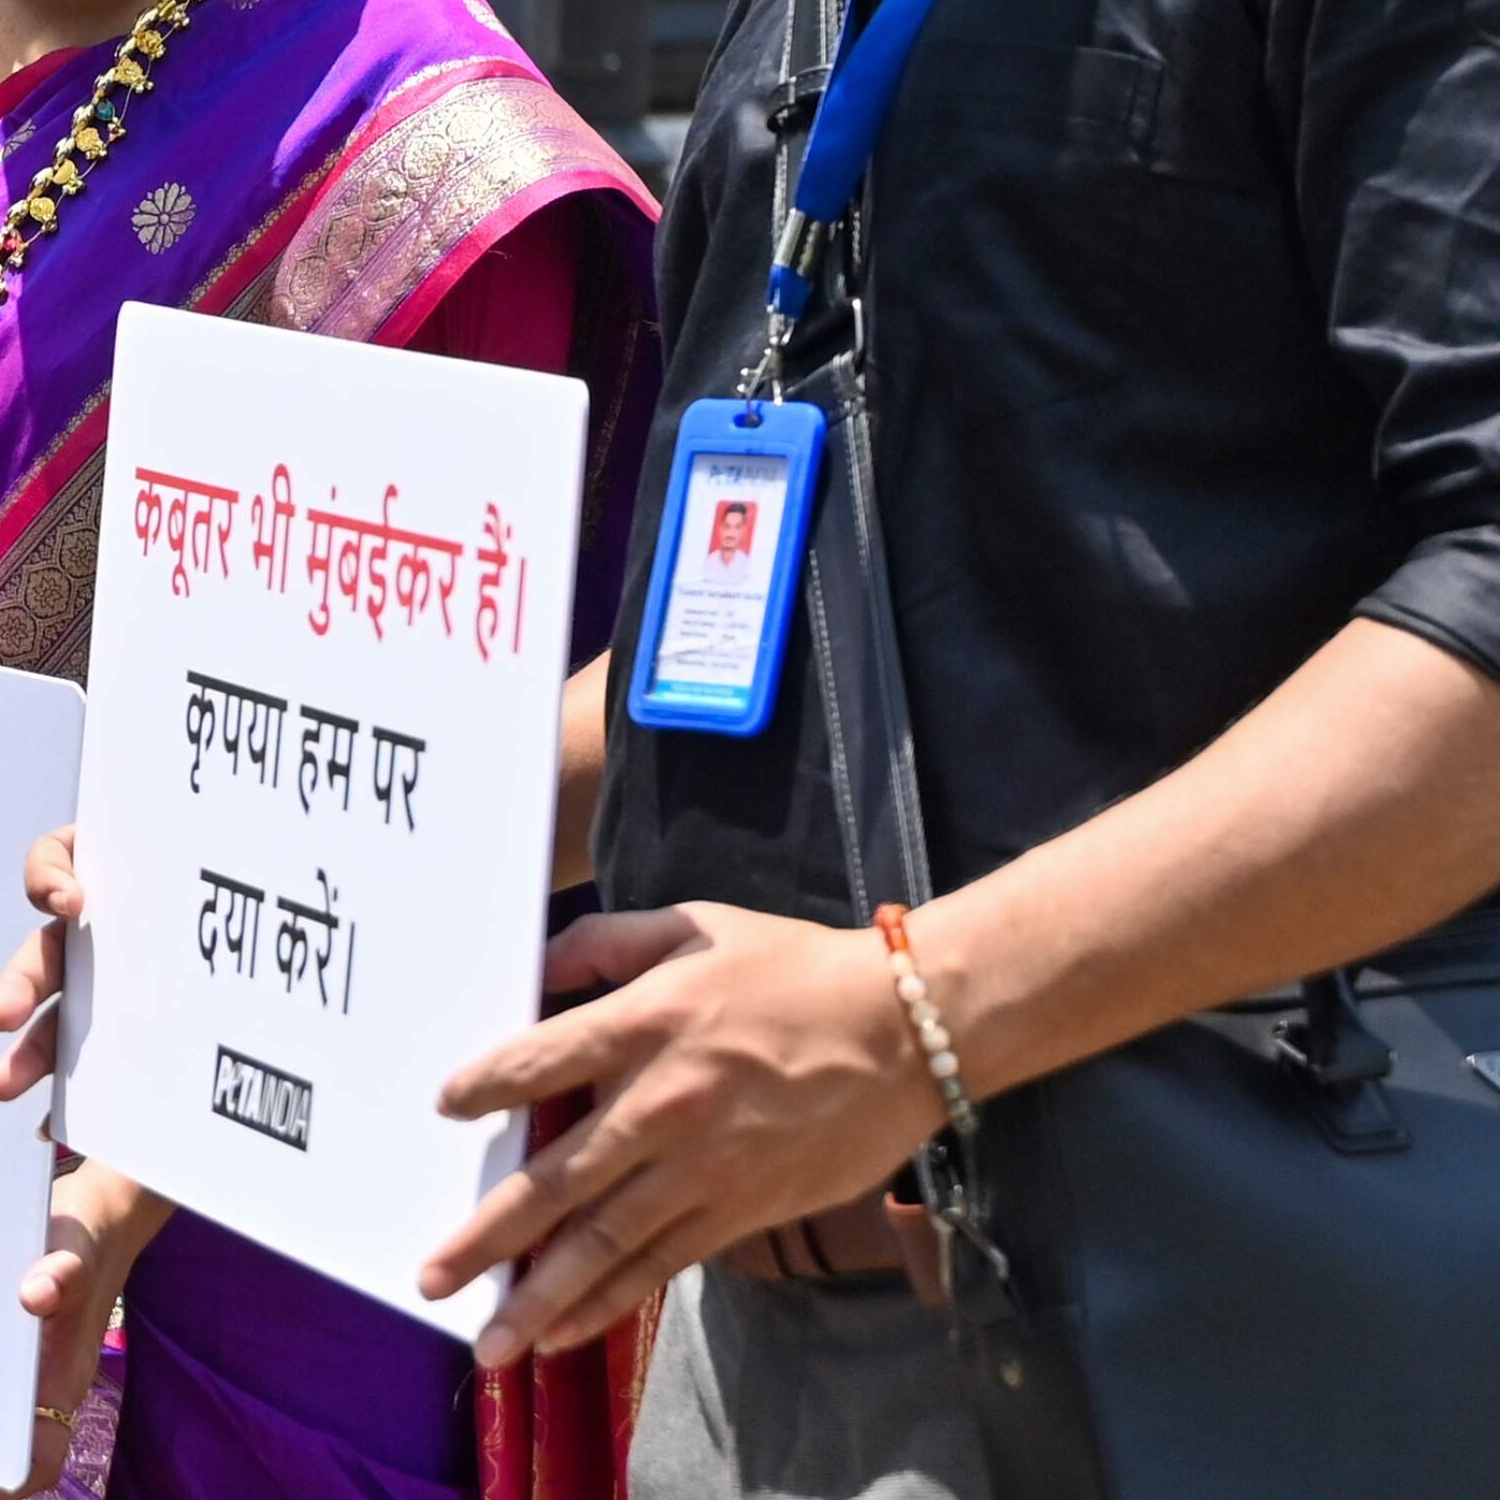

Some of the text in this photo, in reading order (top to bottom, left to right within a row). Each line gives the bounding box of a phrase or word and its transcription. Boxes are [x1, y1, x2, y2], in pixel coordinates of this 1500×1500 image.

[133, 465, 242, 598] कबूतर
[250, 462, 298, 594] भी
[304, 483, 468, 642] मुंबईकर
[186, 670, 426, 831] कृपया हम पर
[198, 868, 266, 980] दया
